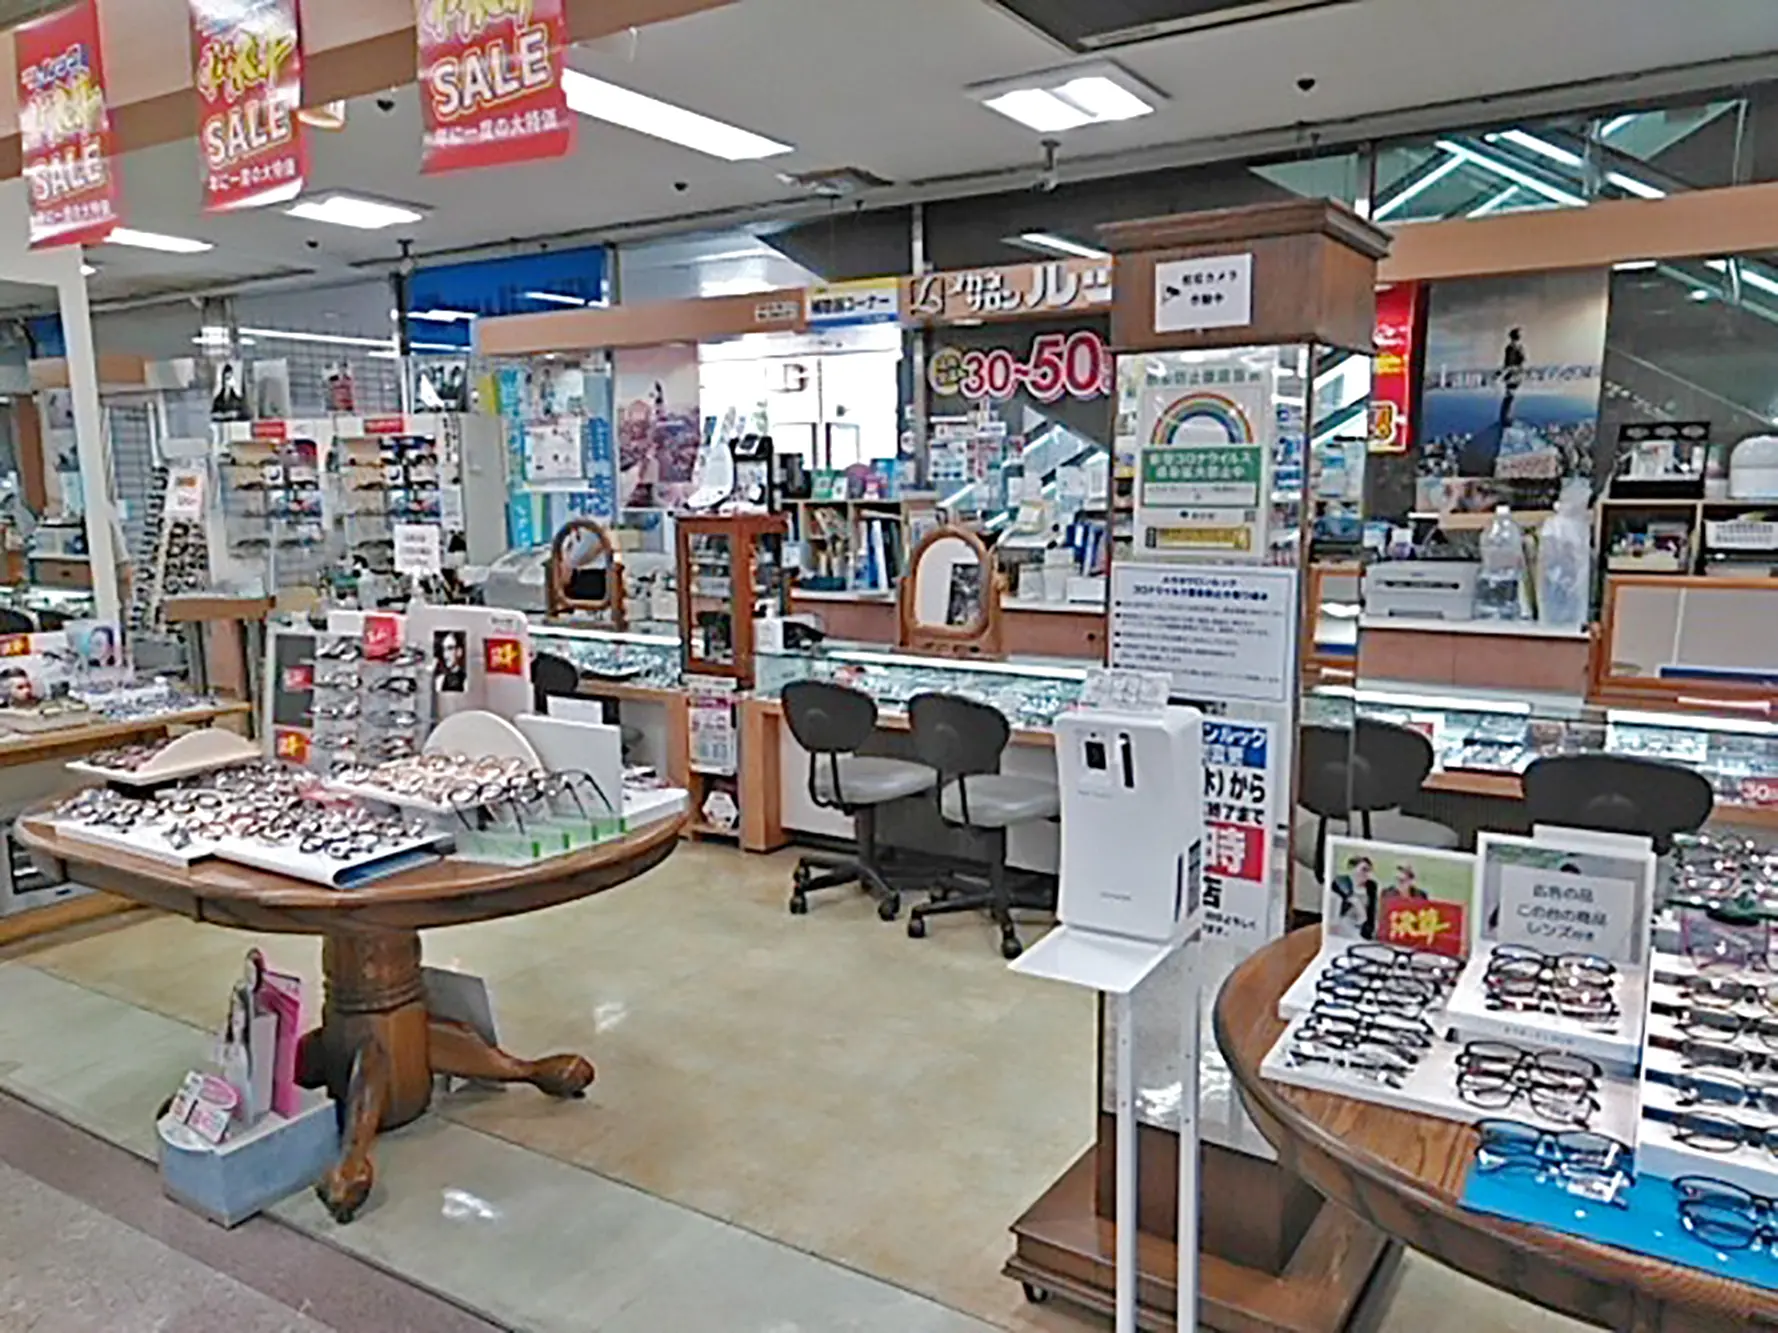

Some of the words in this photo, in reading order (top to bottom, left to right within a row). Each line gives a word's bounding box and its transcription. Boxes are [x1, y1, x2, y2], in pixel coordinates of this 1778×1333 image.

[431, 27, 551, 118] SALE
[205, 101, 292, 168] SALE
[34, 144, 105, 200] SALE
